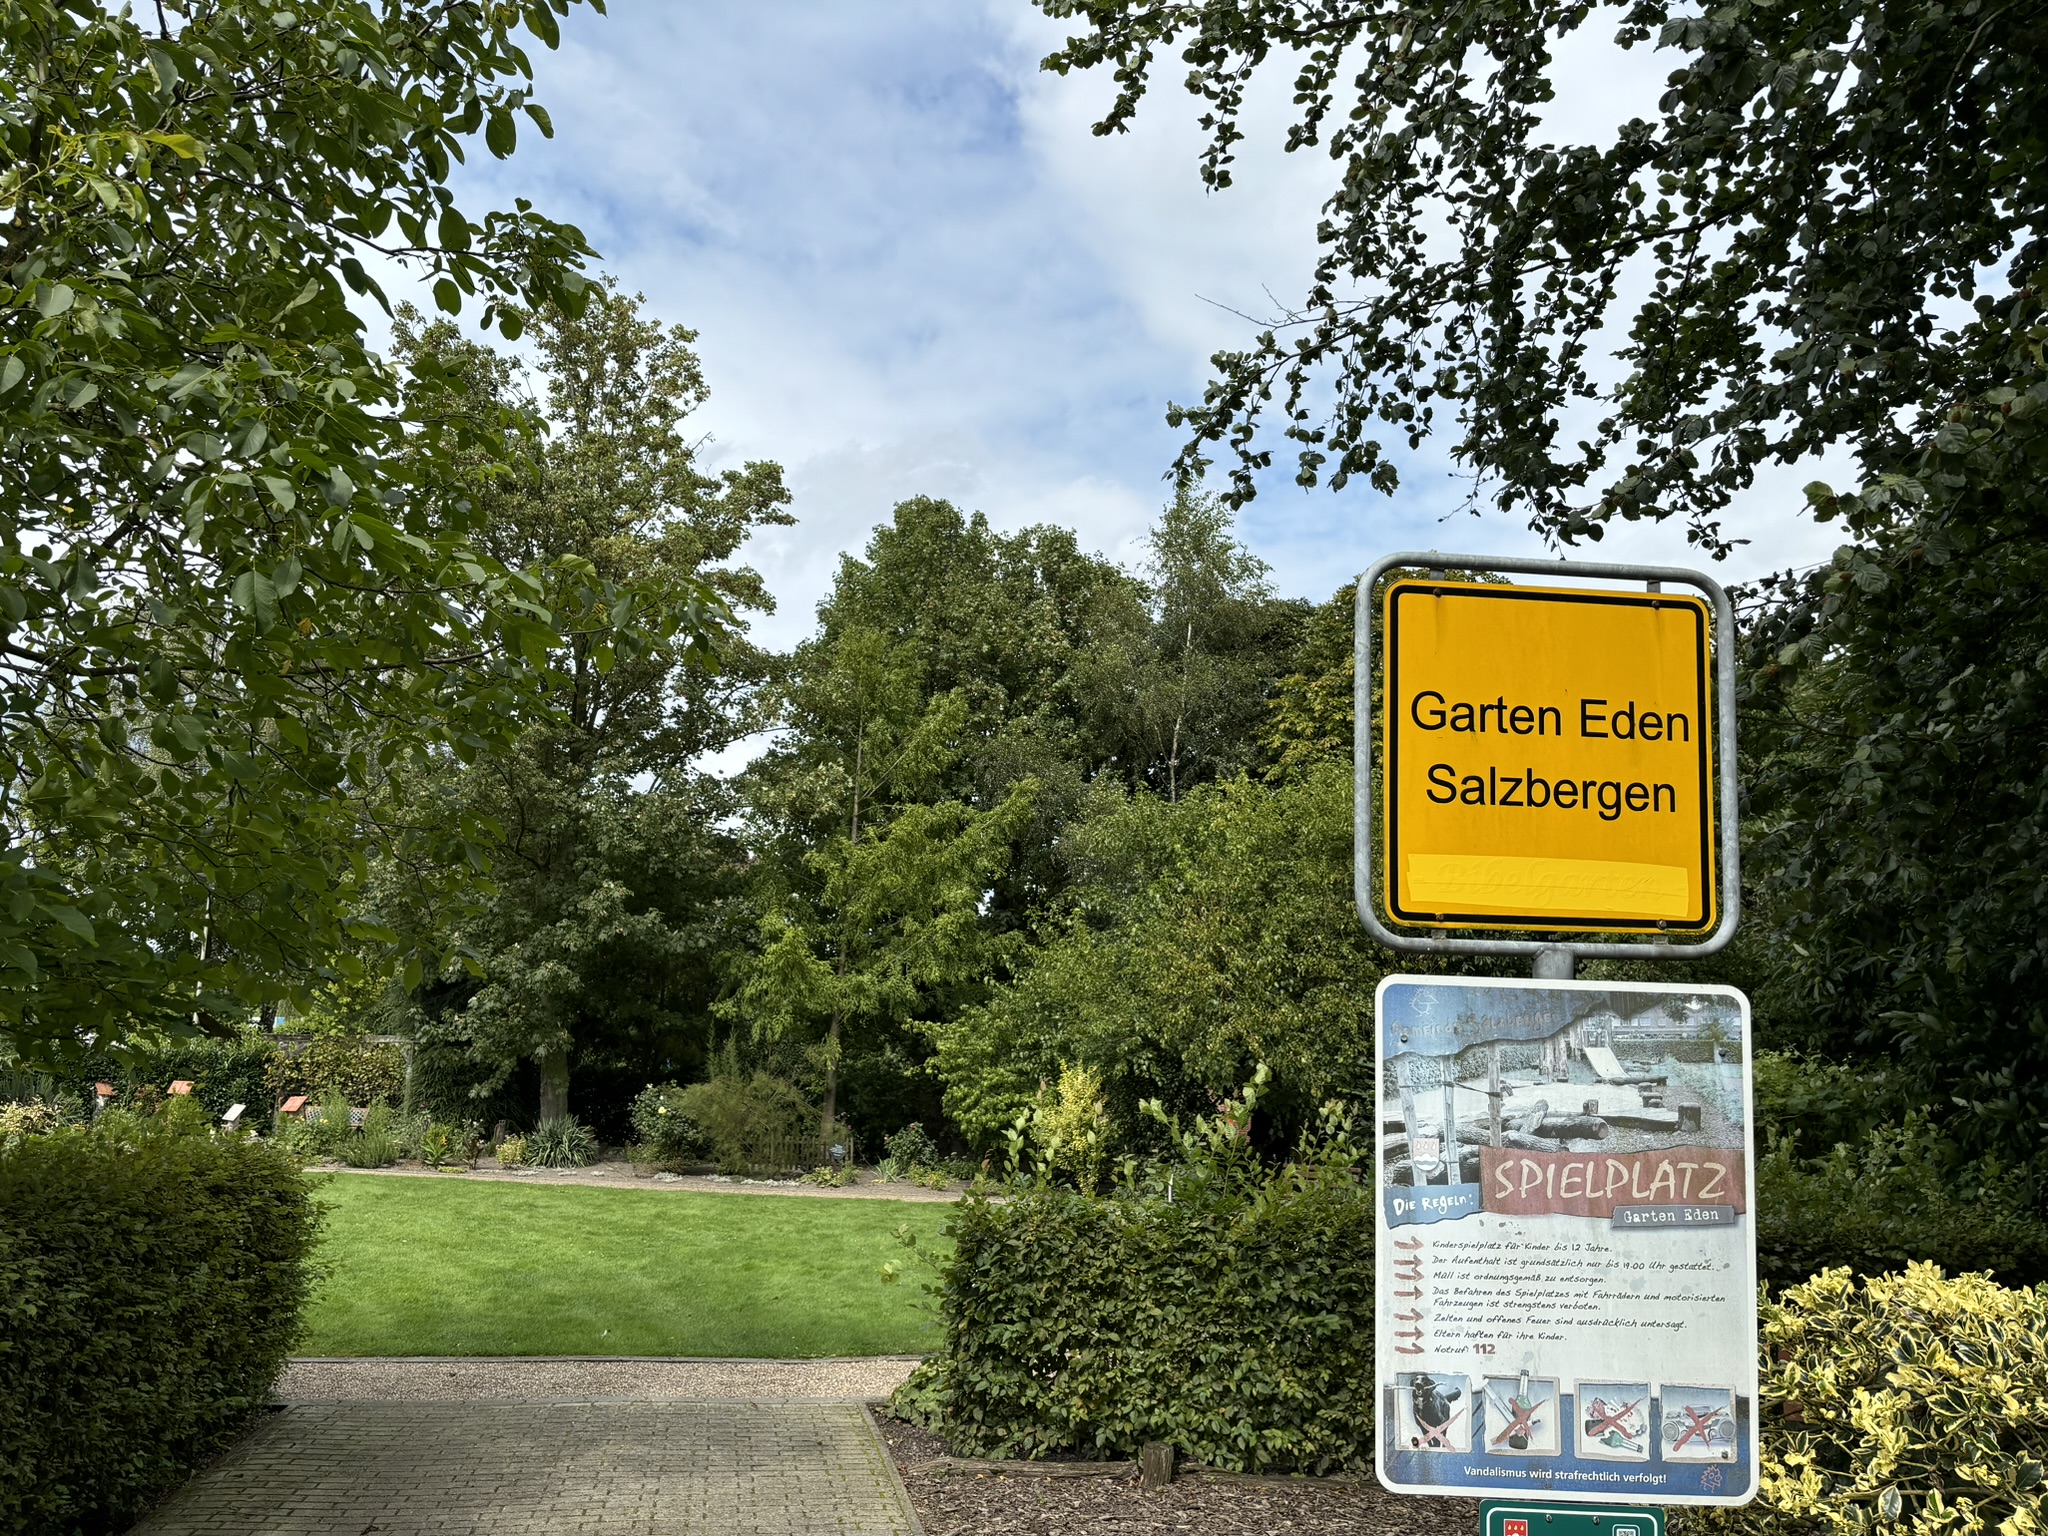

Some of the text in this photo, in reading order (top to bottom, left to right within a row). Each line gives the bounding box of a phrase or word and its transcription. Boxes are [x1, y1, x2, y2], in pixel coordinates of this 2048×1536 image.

[1410, 690, 1690, 742] Garten Eden
[1426, 763, 1676, 821] Salzbergen
[1495, 1158, 1727, 1201] SPIELPLATZ
[1623, 1208, 1720, 1223] Garten Eden
[1432, 1240, 1613, 1253] Kinderspielplatz für Kinder bis 12 Jahre.
[1432, 1255, 1715, 1273] Der Aufenthalt ist grundsätzlich nur bis 19.00 Uhr gestattet.
[1433, 1271, 1455, 1280] Müll
[1457, 1272, 1471, 1280] ist
[1474, 1272, 1541, 1284] ordnungsgemäß
[1559, 1275, 1607, 1286] entsorgen.
[1432, 1286, 1726, 1302] Das Befahren des Spielplatzes mit Fahrrädern und motorisierten
[1433, 1297, 1601, 1312] Fahrzeugen ist strengstens verboten.
[1433, 1313, 1688, 1332] Zelten und offenes Feuer sind ausdrücklich untersagt.
[1433, 1329, 1568, 1341] Eltern haften für ihre Kinder.
[1434, 1343, 1496, 1355] Notruf: 112
[1463, 1465, 1667, 1485] Vandalismus wird strafrechtlich verfolgt!
